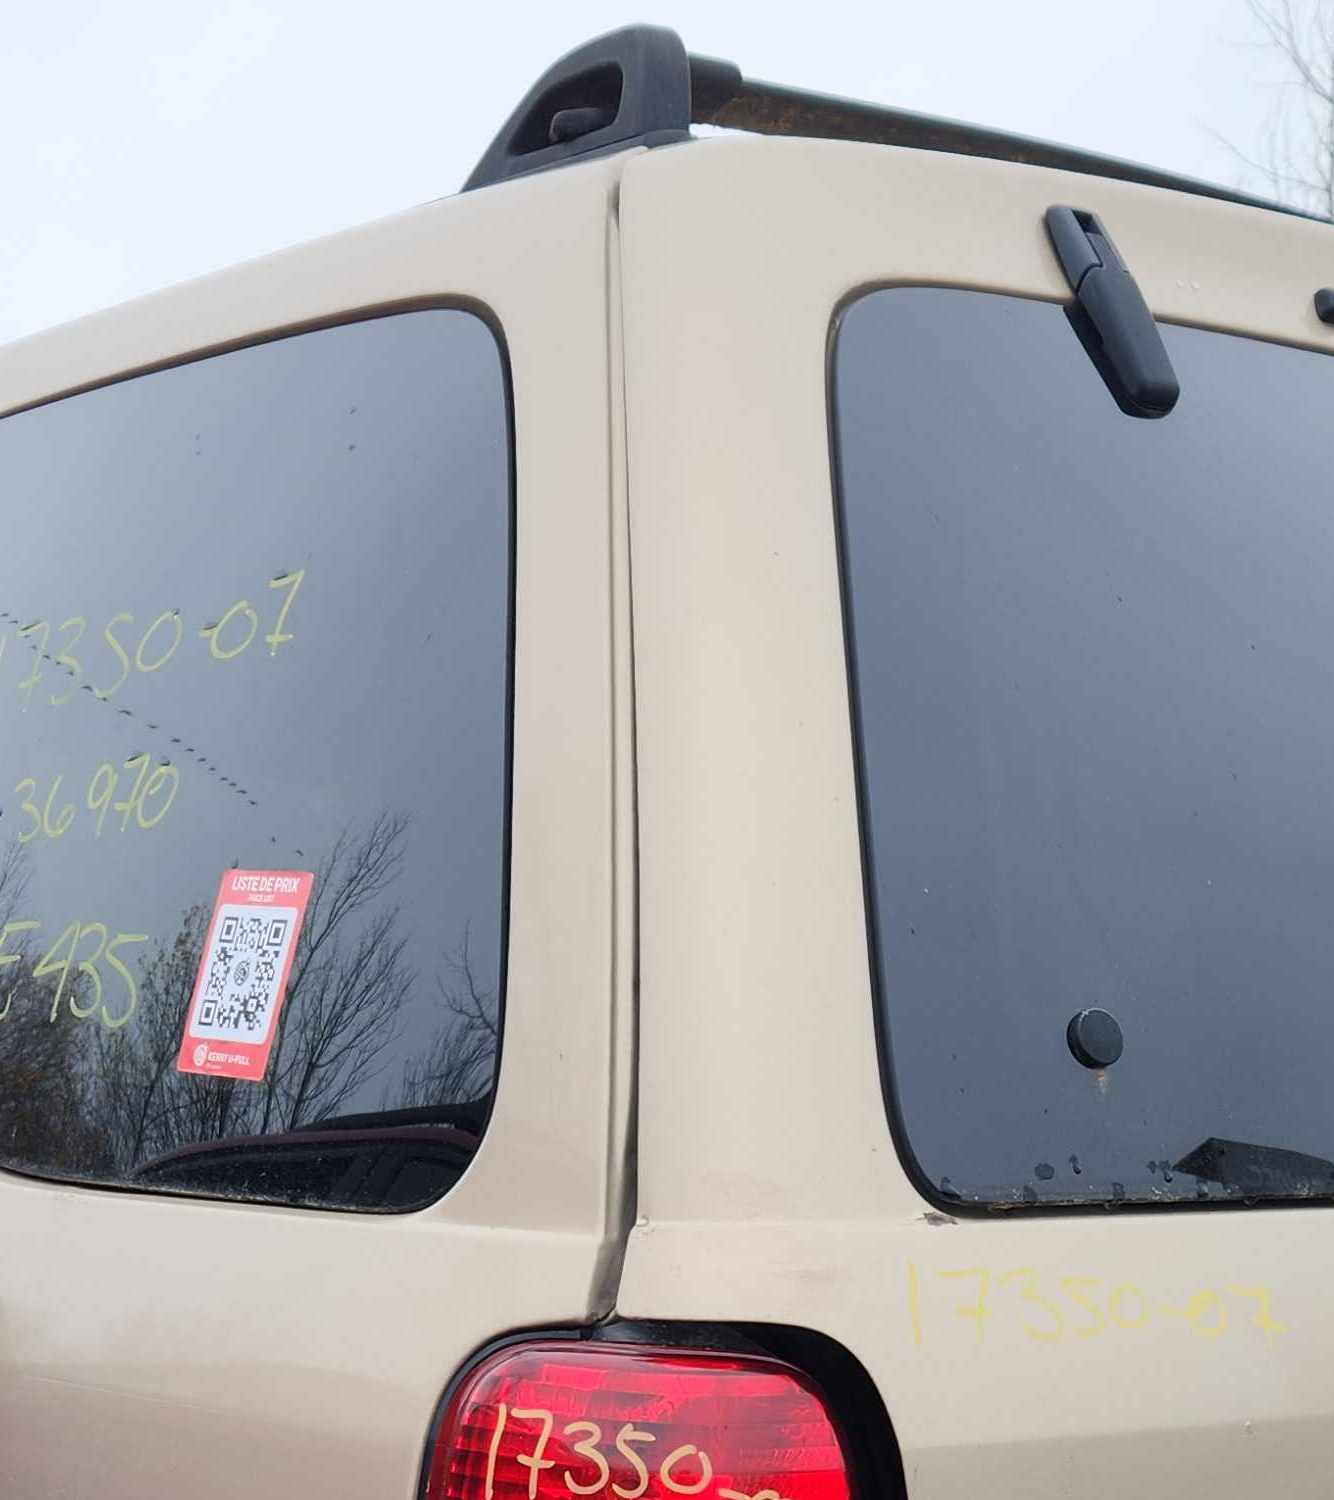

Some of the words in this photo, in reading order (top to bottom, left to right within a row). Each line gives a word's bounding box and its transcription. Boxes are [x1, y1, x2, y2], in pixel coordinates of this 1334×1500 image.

[231, 875, 258, 891] LISTE
[258, 876, 274, 892] DE
[274, 876, 301, 893] PRIX
[907, 1258, 1287, 1350] 17350-07
